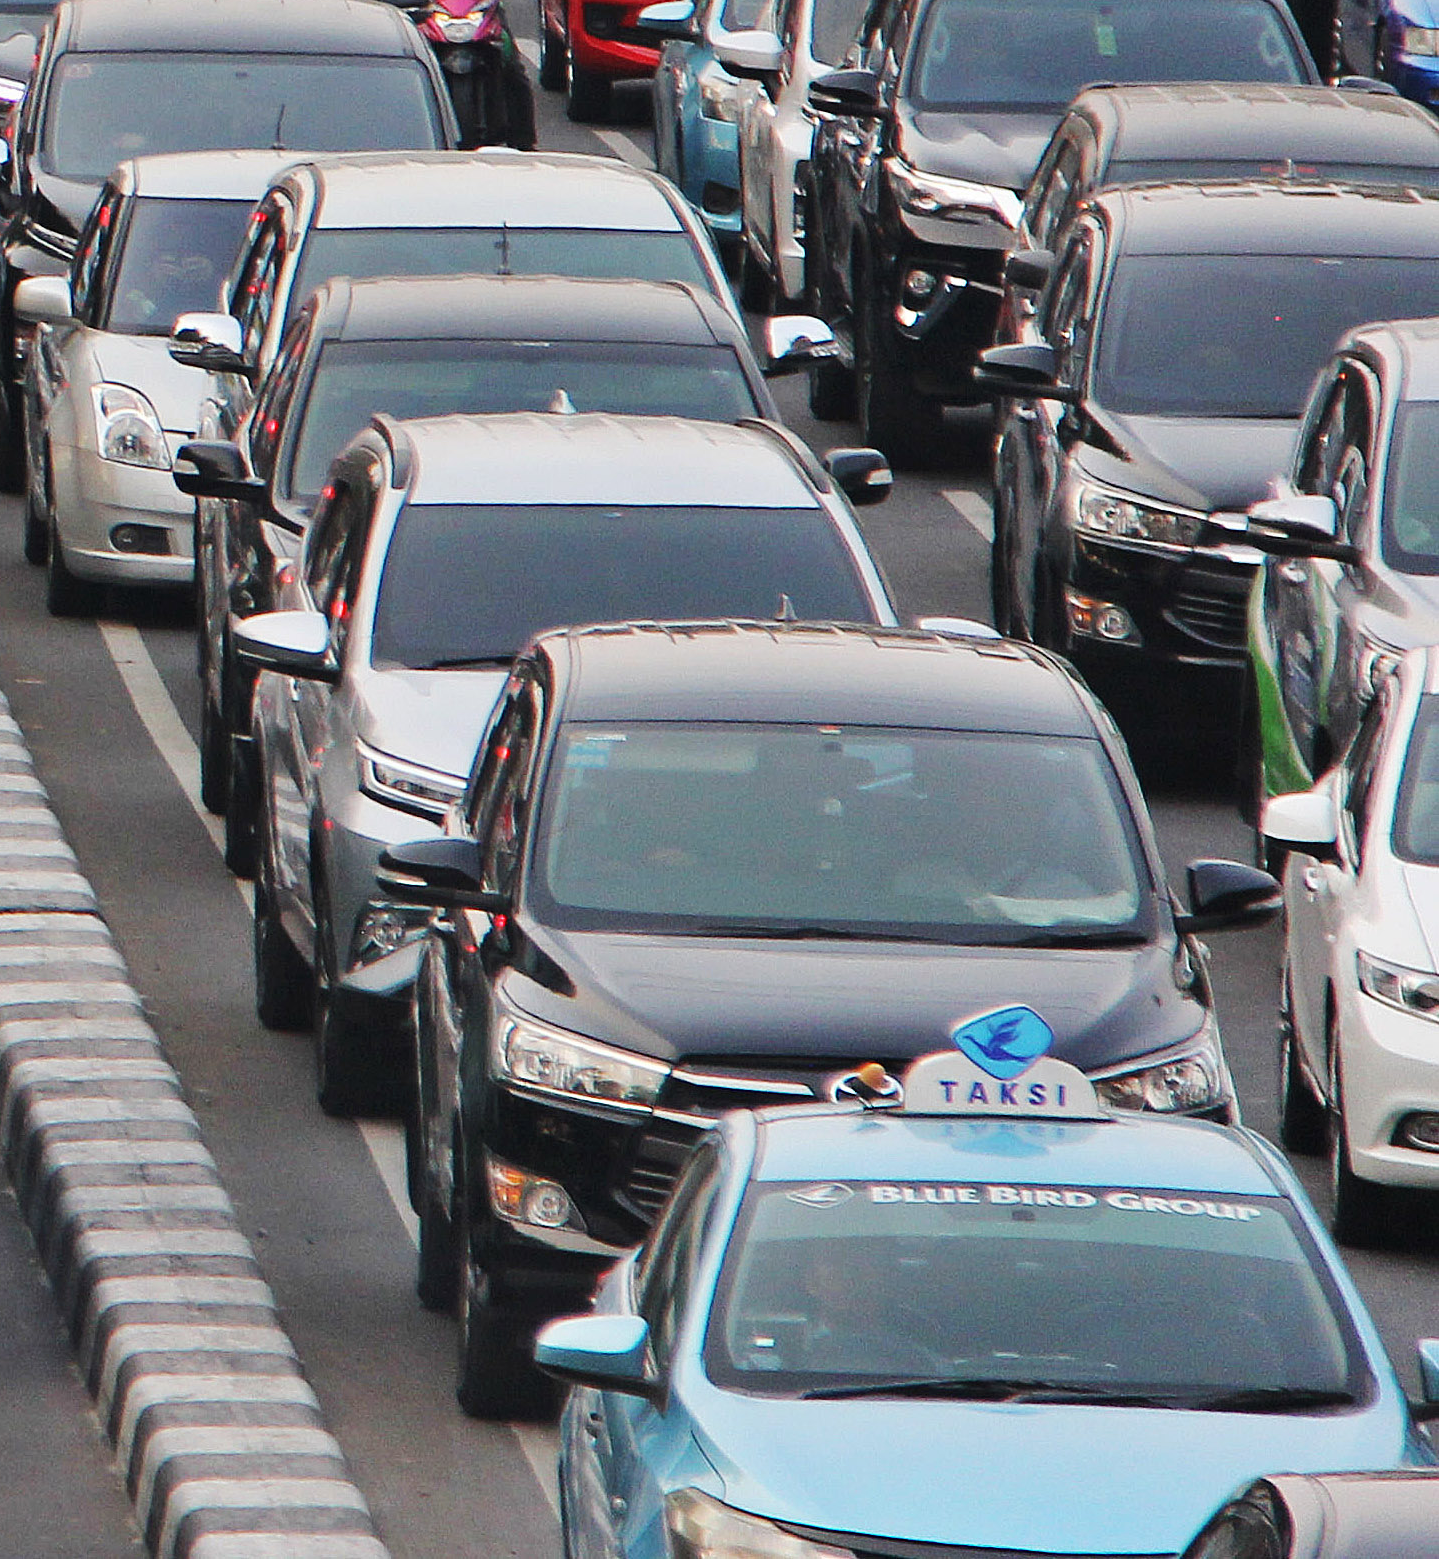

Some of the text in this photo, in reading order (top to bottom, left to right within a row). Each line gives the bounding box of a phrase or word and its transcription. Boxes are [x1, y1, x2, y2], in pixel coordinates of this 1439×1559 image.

[939, 1079, 1067, 1107] TAKSI
[871, 1184, 1262, 1223] BLUE BIRD GROUP
